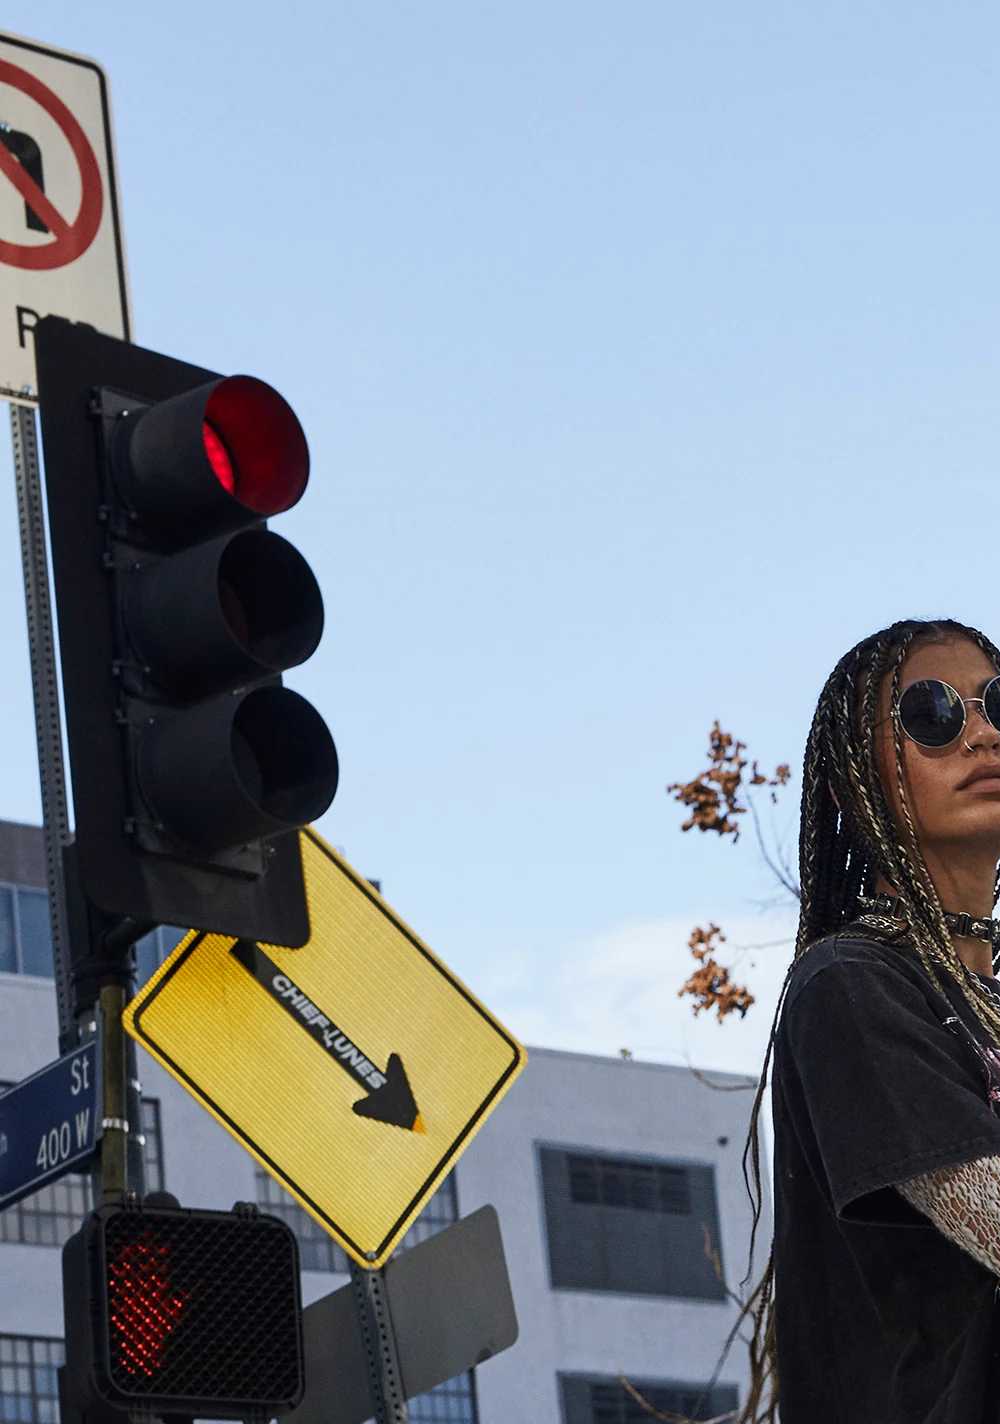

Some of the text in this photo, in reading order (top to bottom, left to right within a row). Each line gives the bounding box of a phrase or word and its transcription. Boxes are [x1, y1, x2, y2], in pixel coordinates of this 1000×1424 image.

[71, 1055, 89, 1096] St
[36, 1122, 71, 1170] 400
[75, 1107, 90, 1149] W
